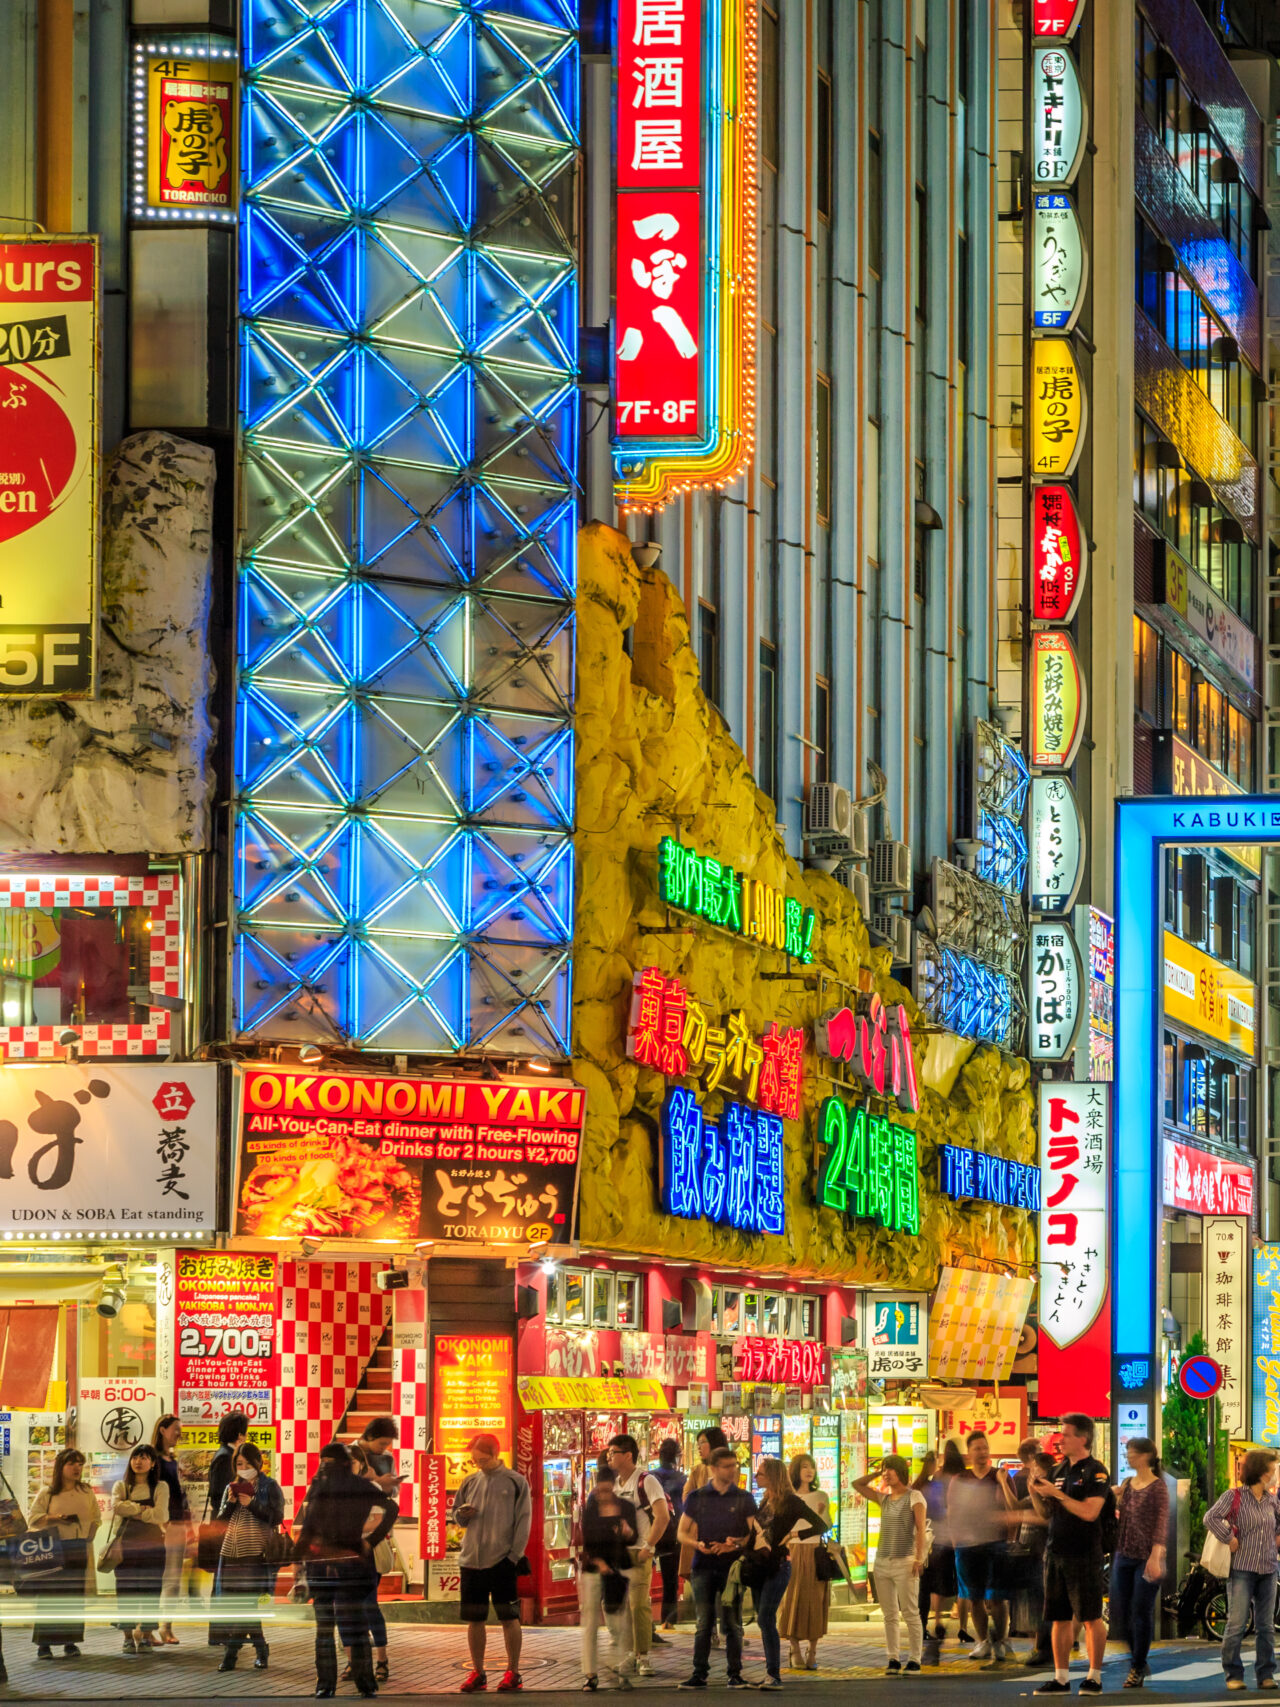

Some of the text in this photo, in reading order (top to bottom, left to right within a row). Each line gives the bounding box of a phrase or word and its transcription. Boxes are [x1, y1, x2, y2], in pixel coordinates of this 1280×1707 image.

[1038, 20, 1065, 32] 7F
[153, 61, 191, 77] 4F
[631, 0, 685, 171] 居酒屋
[174, 108, 213, 175] 虎の子
[1037, 160, 1068, 179] 6F
[163, 188, 228, 204] TORANOKO
[1037, 196, 1066, 208] 酒処
[1040, 226, 1067, 304] うさぎや
[617, 213, 698, 362] つぼ八
[1042, 313, 1062, 325] 5F
[1036, 365, 1074, 375] 居酒屋本舗
[1038, 377, 1074, 443] 虎の子
[1037, 456, 1060, 469] 4F
[0, 633, 80, 685] 5F
[1042, 653, 1065, 751] お好み焼き
[1036, 753, 1062, 764] 2階
[1046, 805, 1065, 889] とらそば
[1039, 896, 1061, 910] 1F
[1036, 935, 1064, 947] 新宿
[1036, 949, 1065, 1025] かっぱ
[1039, 1034, 1061, 1049] B1
[250, 1074, 581, 1124] OKONOMI YAKI
[249, 1115, 578, 1147] All-You-Can-Eat dinner with Free-Flowing
[1083, 1087, 1104, 1175] 大衆酒場
[263, 1141, 286, 1150] kinds
[300, 1138, 327, 1147] drinks
[381, 1140, 576, 1164] Drinks for 2 hours ¥2,700
[156, 1126, 190, 1200] 蕎麦
[274, 1151, 334, 1162] kinds of foods
[668, 1086, 785, 1235] 飲み放題
[819, 1096, 919, 1236] 24時間
[943, 1147, 975, 1200] THE
[1047, 1098, 1080, 1246] トラノコ
[12, 1208, 204, 1223] UDON & SOBA Eat standing
[443, 1224, 549, 1240] TORADYU 2F
[179, 1255, 274, 1279] お好み焼き
[178, 1280, 274, 1293] OKONOMI YAKI
[1073, 1247, 1098, 1310] やきとり
[179, 1301, 225, 1312] YAKISOBA
[1215, 1271, 1234, 1353] 珈琲茶館
[180, 1328, 271, 1357] 2,700円
[437, 1338, 508, 1353] OKONOMI
[456, 1353, 492, 1367] YAKI
[871, 1357, 924, 1373] 虎の子
[474, 1417, 503, 1427] Sauce
[958, 1420, 1017, 1437] トラノコ
[427, 1458, 440, 1557] とらぢゅう営業中
[19, 1534, 54, 1556] GU
[23, 1552, 54, 1565] JEANS
